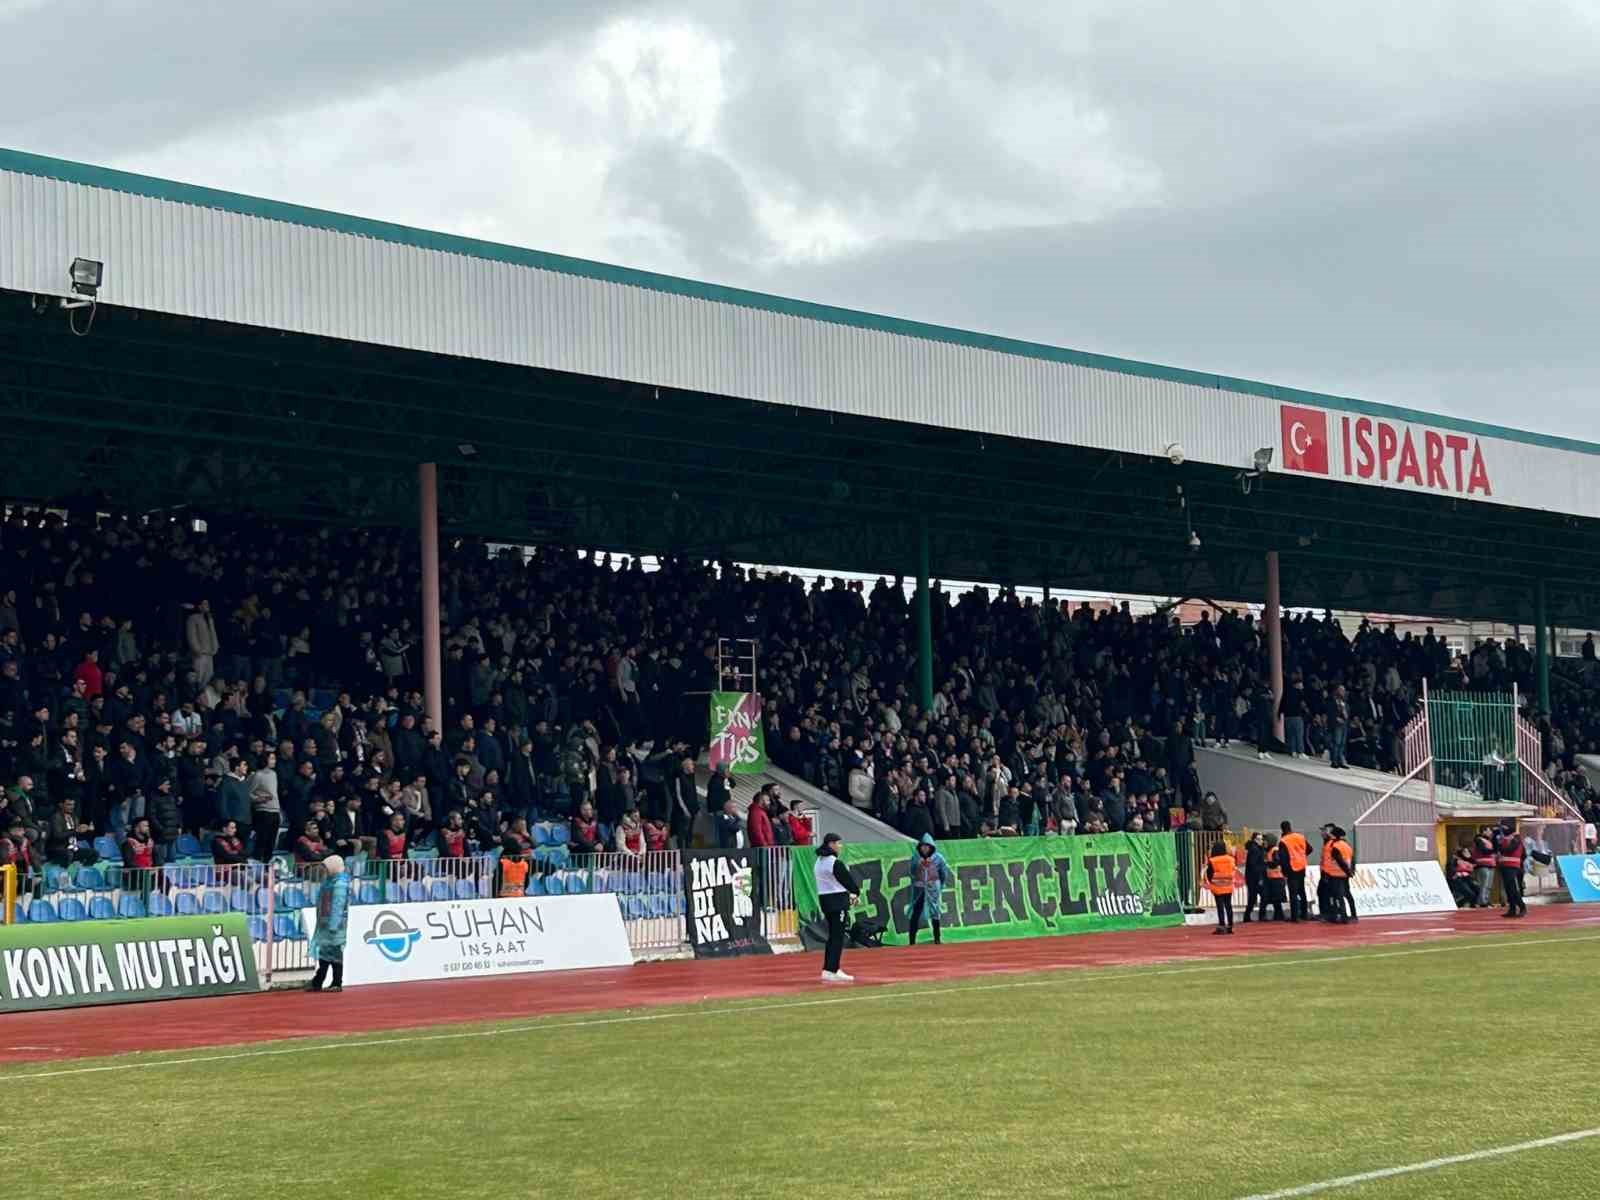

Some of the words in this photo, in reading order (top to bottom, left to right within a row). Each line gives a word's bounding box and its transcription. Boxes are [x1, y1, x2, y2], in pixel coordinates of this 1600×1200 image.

[1342, 417, 1492, 496] ISPARTA
[1376, 867, 1424, 889] SOLAR
[1096, 888, 1144, 916] ultras
[426, 903, 544, 940] SÜHAN
[696, 913, 729, 944] NA
[3, 945, 114, 1000] KONYA
[115, 925, 246, 991] MUTFAĞI
